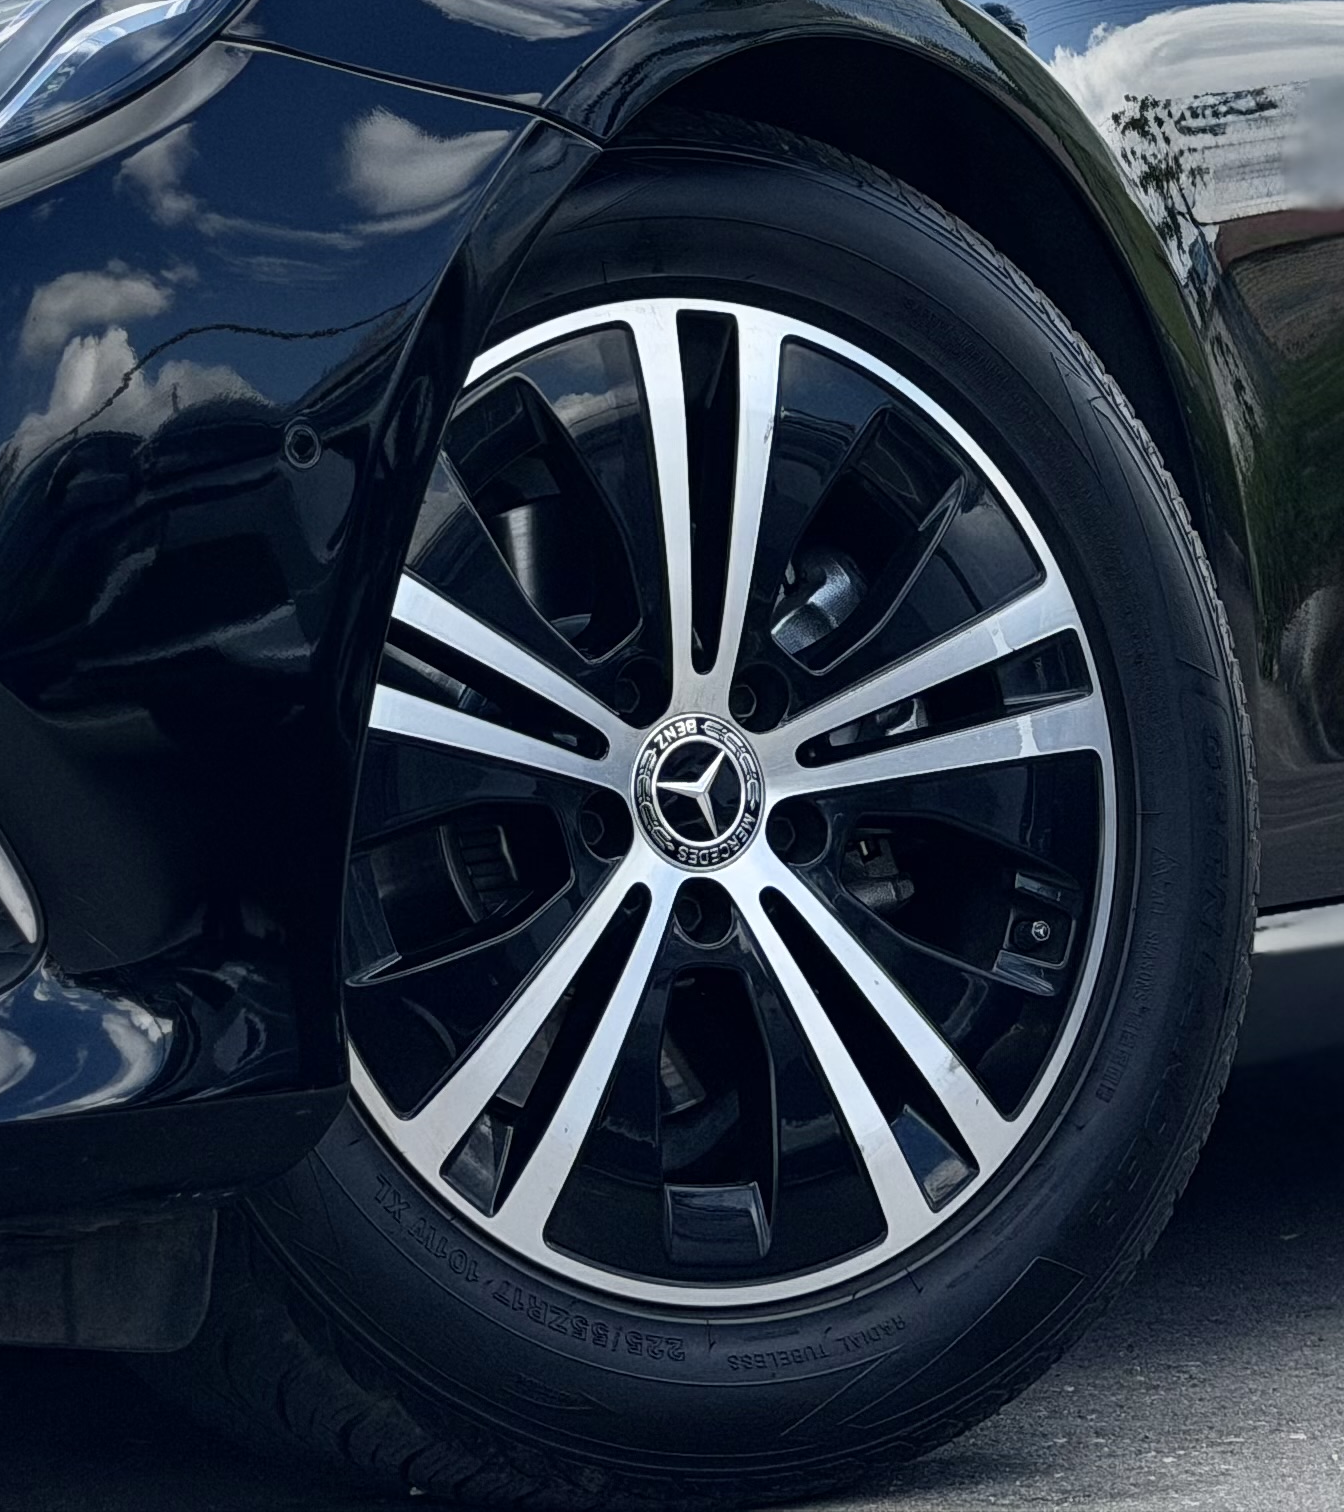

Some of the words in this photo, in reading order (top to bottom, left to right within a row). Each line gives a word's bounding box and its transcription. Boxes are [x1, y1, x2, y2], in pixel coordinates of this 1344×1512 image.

[654, 719, 697, 750] BENZ
[677, 812, 756, 864] MERCEDES
[374, 1173, 410, 1224] XL
[492, 1277, 686, 1362] 225/55ZR17
[835, 1314, 906, 1354] RADIAL
[726, 1343, 829, 1372] TUBELESS
